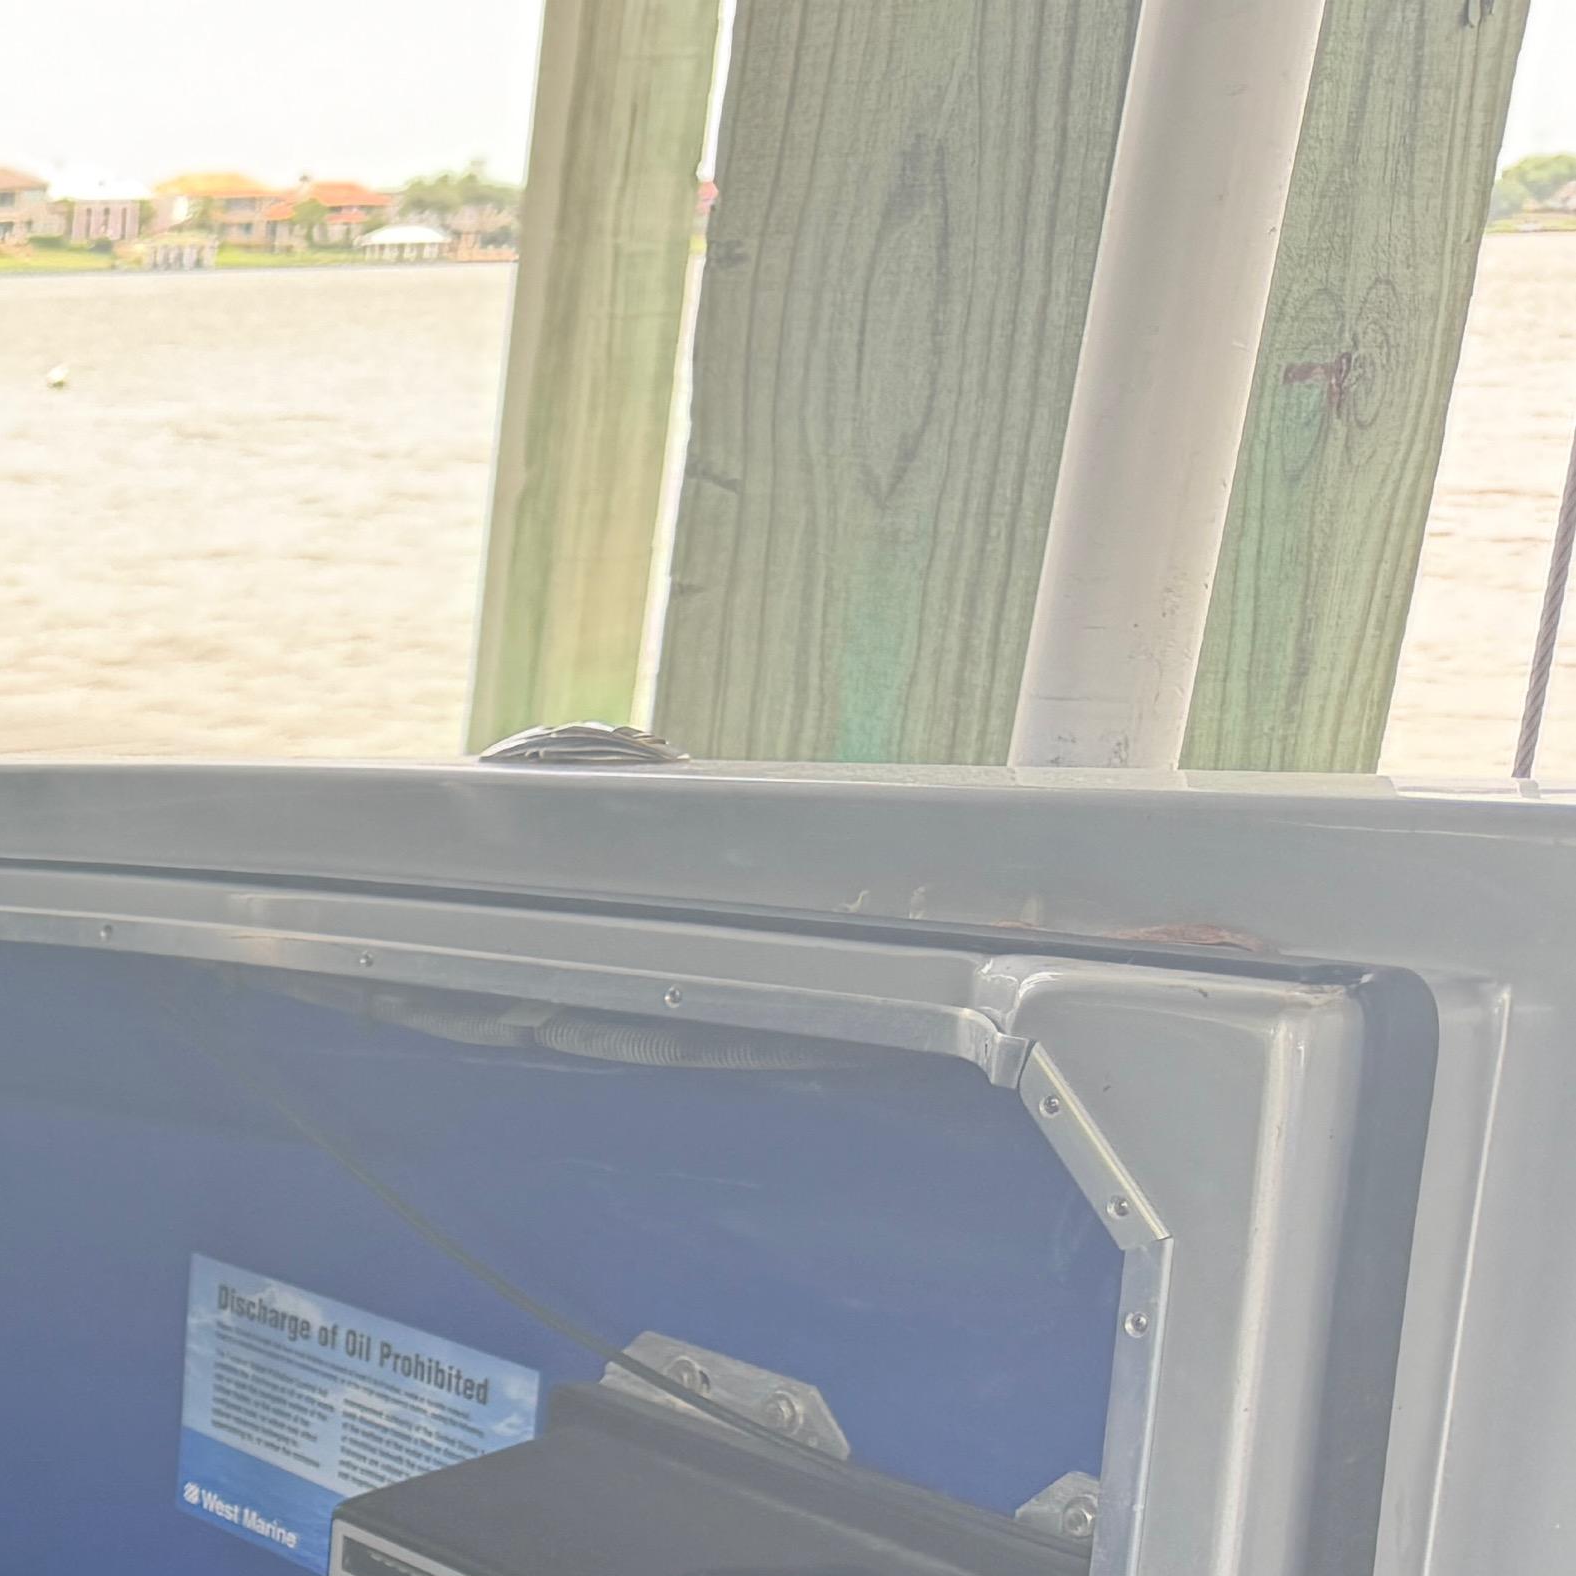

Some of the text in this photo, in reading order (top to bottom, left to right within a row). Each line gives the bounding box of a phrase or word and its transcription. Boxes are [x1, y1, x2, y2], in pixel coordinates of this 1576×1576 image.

[218, 1284, 490, 1405] Discharge of Oil Prohibited
[201, 1488, 298, 1548] West Marine
